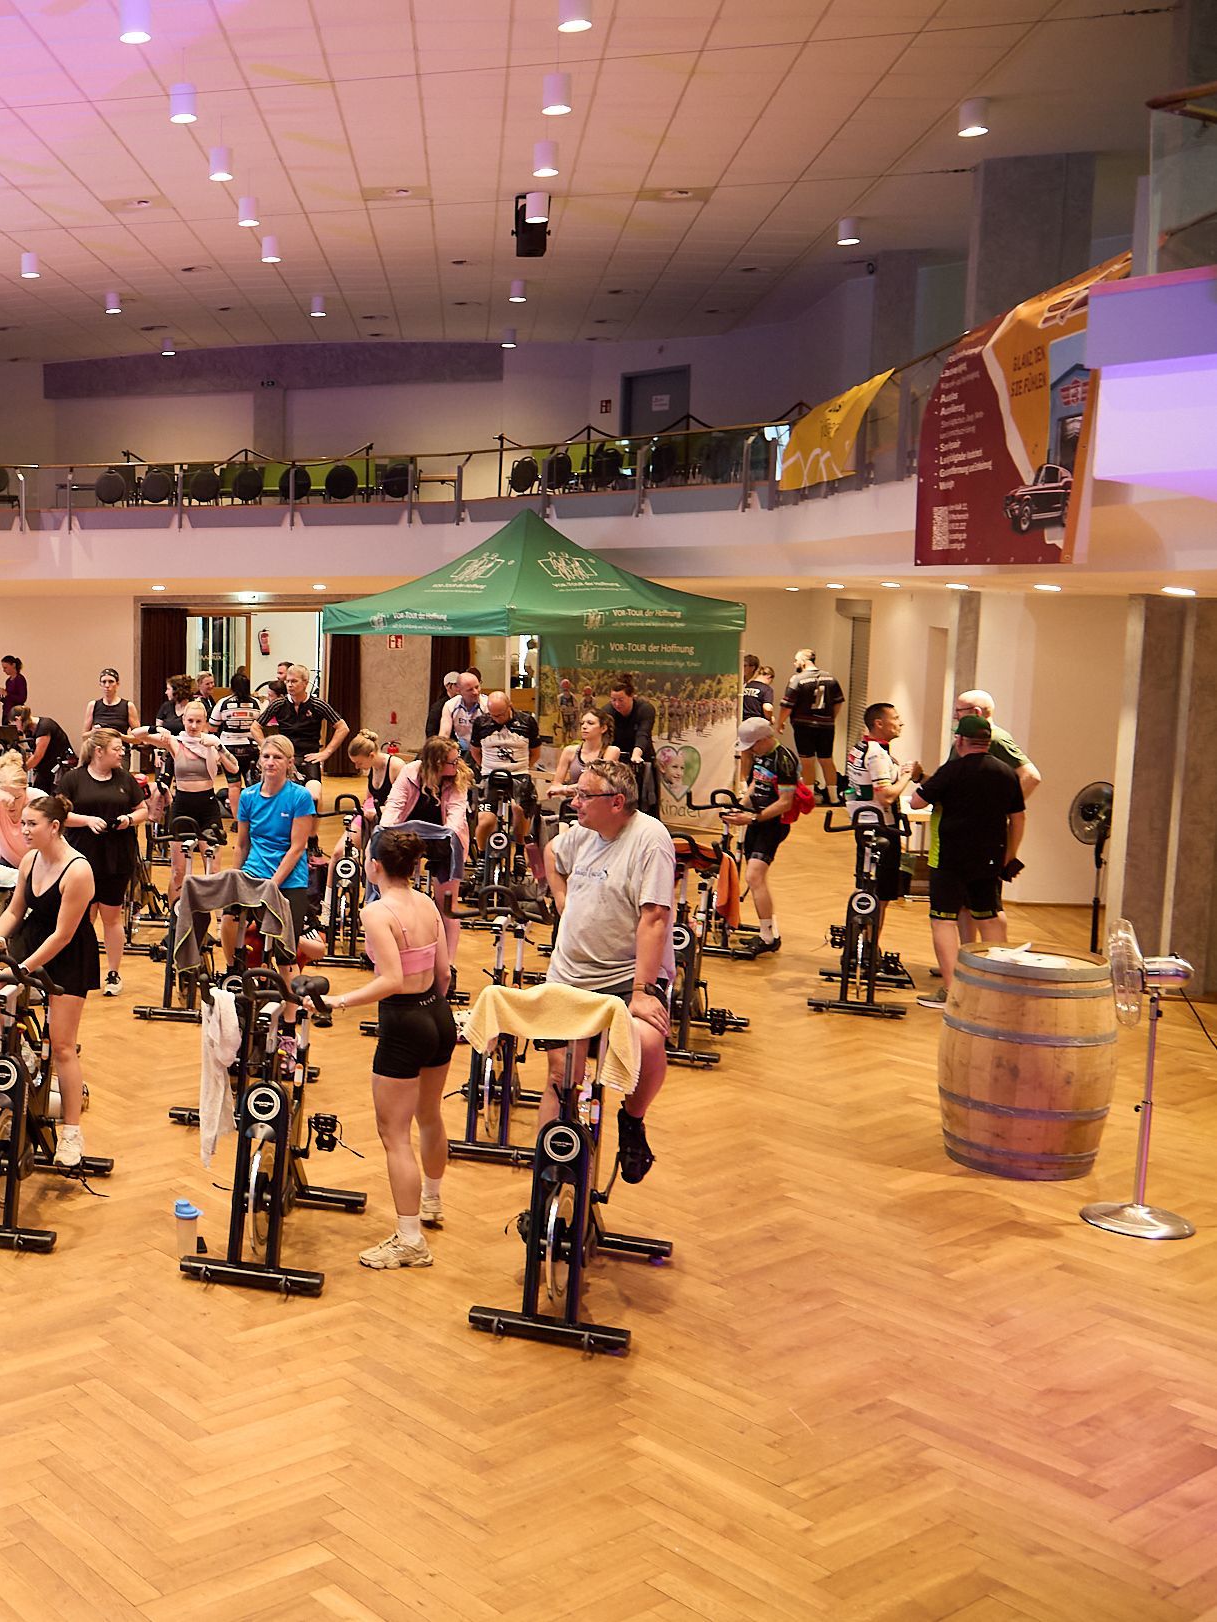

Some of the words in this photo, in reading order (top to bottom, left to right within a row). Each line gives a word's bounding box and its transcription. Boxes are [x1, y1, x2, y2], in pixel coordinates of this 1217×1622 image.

[612, 609, 643, 617] VOR-TOUR
[645, 609, 654, 617] der
[655, 609, 682, 619] Hoffnung
[609, 642, 647, 652] VOR-TOUR
[648, 643, 660, 653] der
[661, 643, 695, 656] Hoffnung
